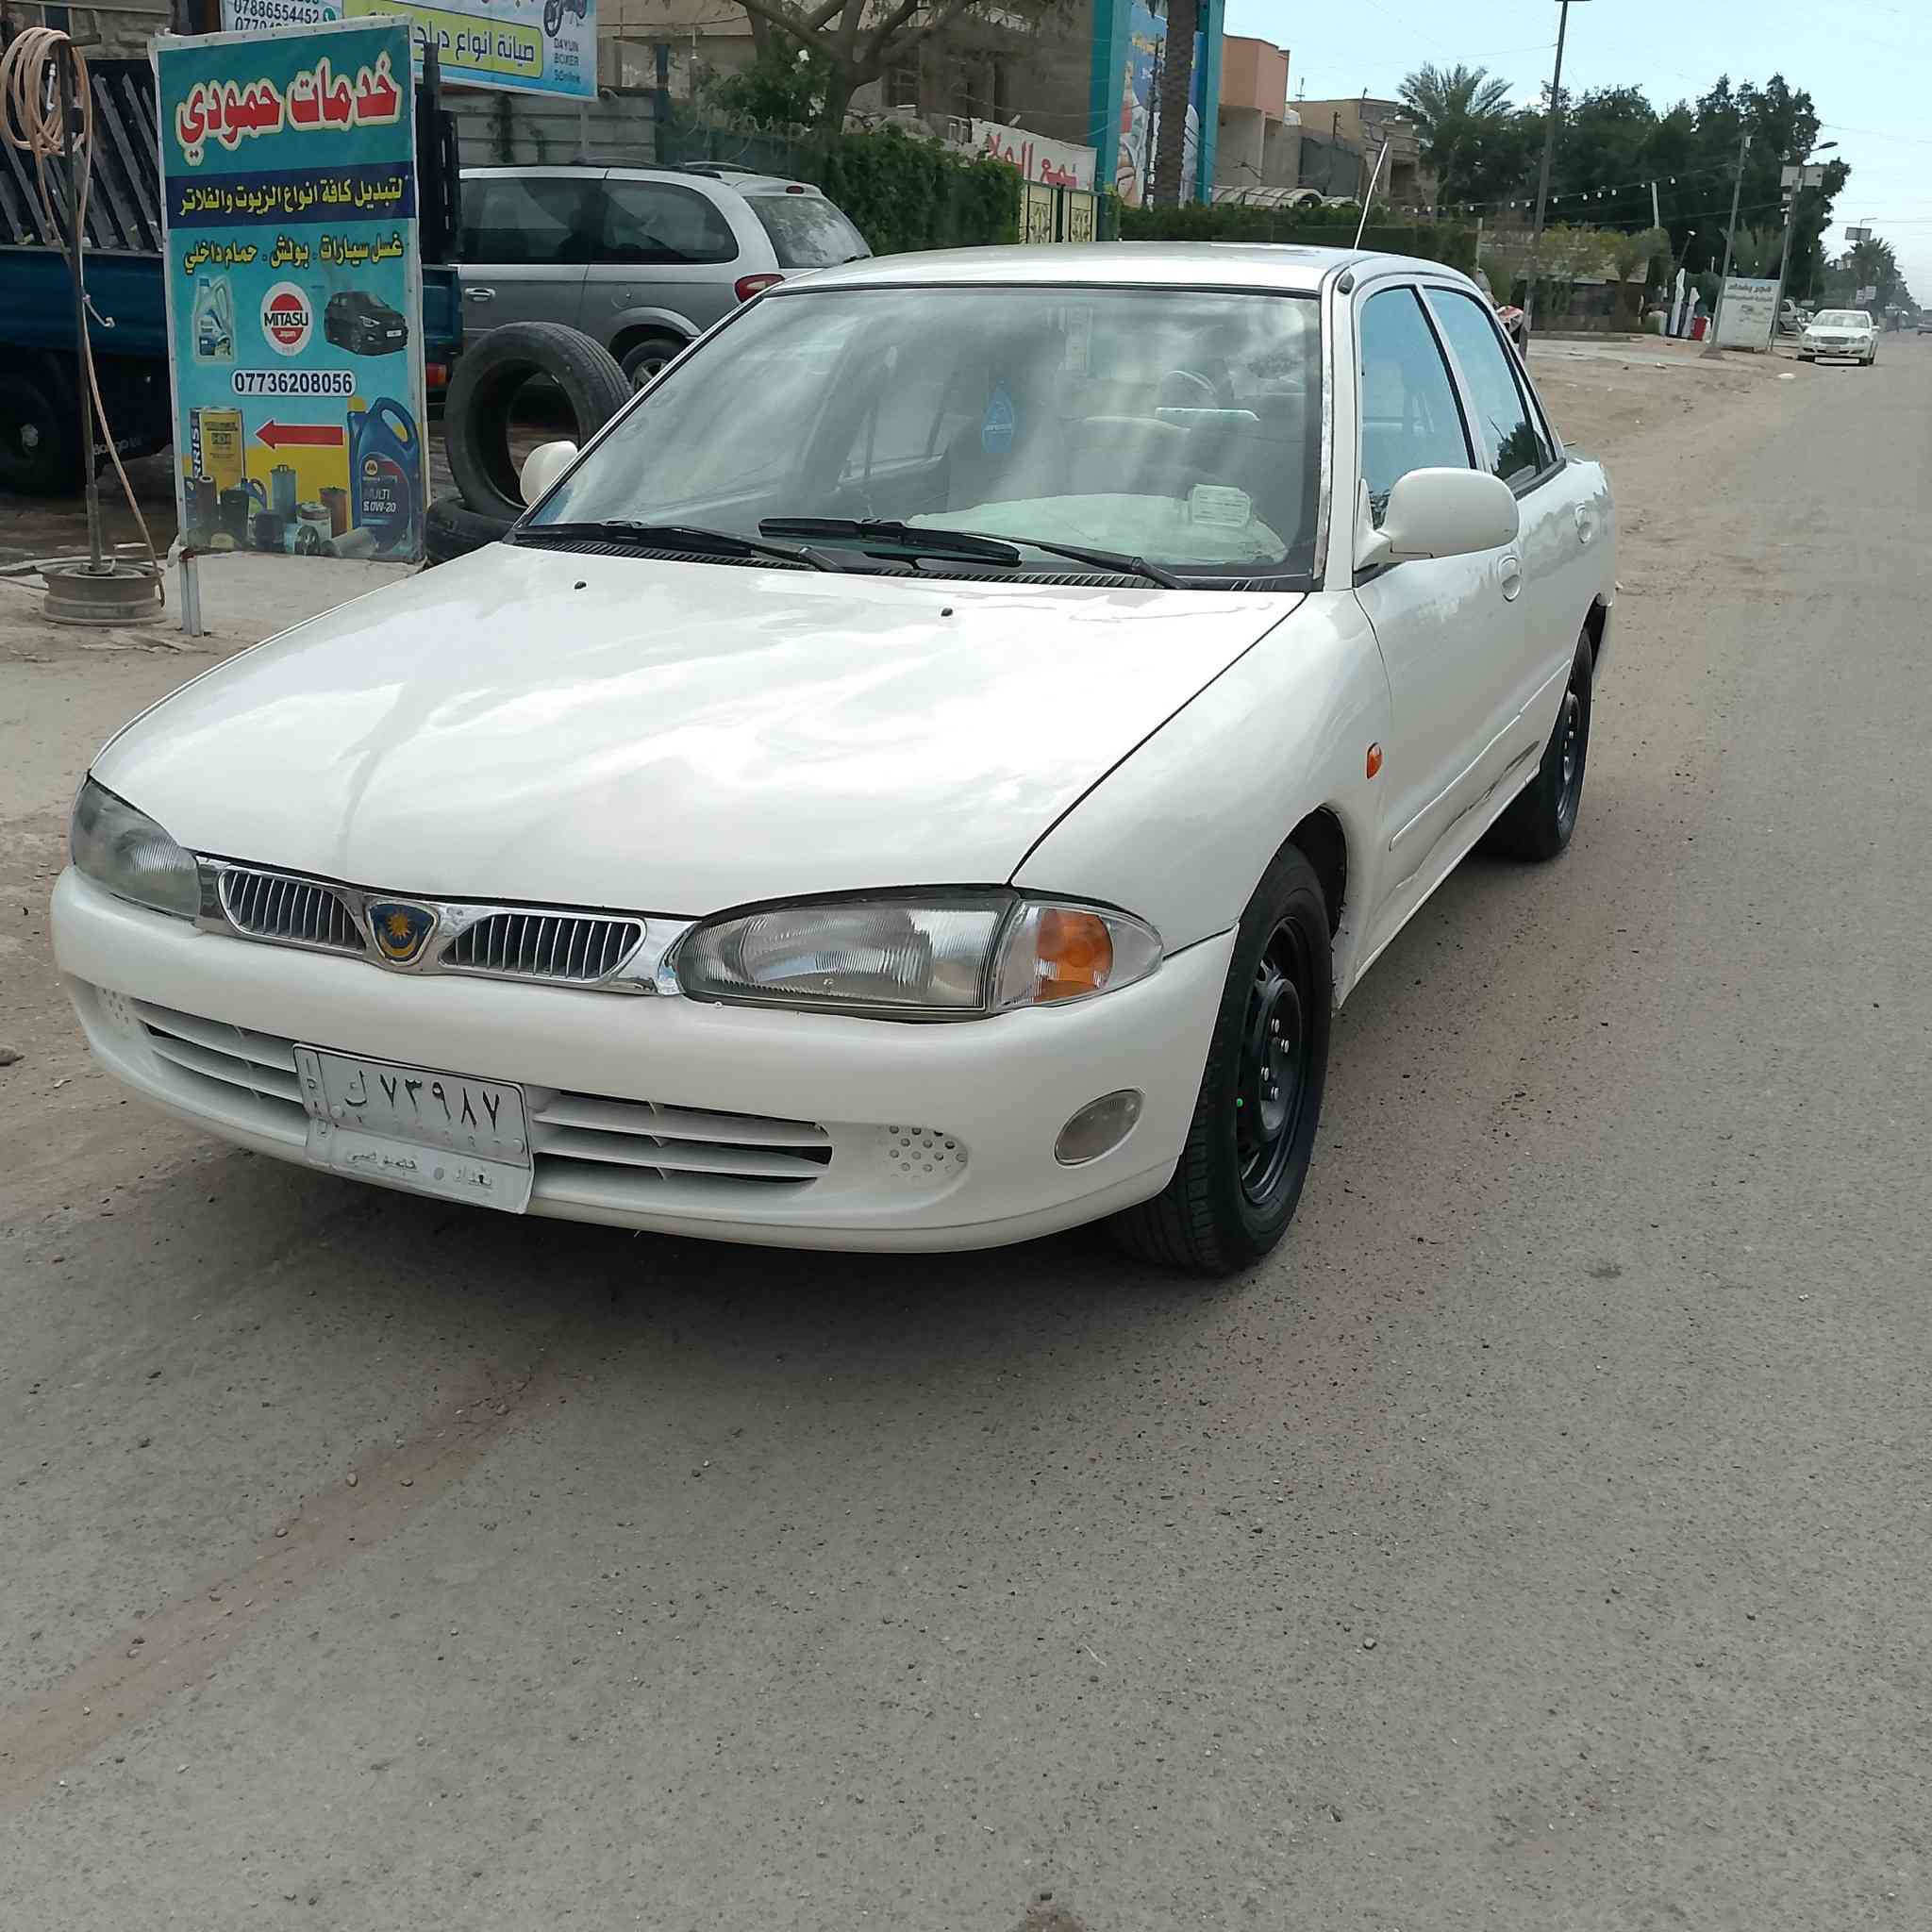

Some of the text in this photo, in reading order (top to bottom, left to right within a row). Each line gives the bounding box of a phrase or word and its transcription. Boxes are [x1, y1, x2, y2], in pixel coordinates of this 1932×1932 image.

[457, 26, 492, 61] انواع
[497, 34, 535, 67] صيانة
[176, 54, 400, 162] خدمات حمودي
[179, 176, 403, 216] لتبديل كافة انواع الزيوت والفلاتر
[184, 233, 403, 275] غسل سيارات بولش حمام داخلي
[263, 311, 309, 326] MITASU
[234, 372, 354, 394] 07736208056
